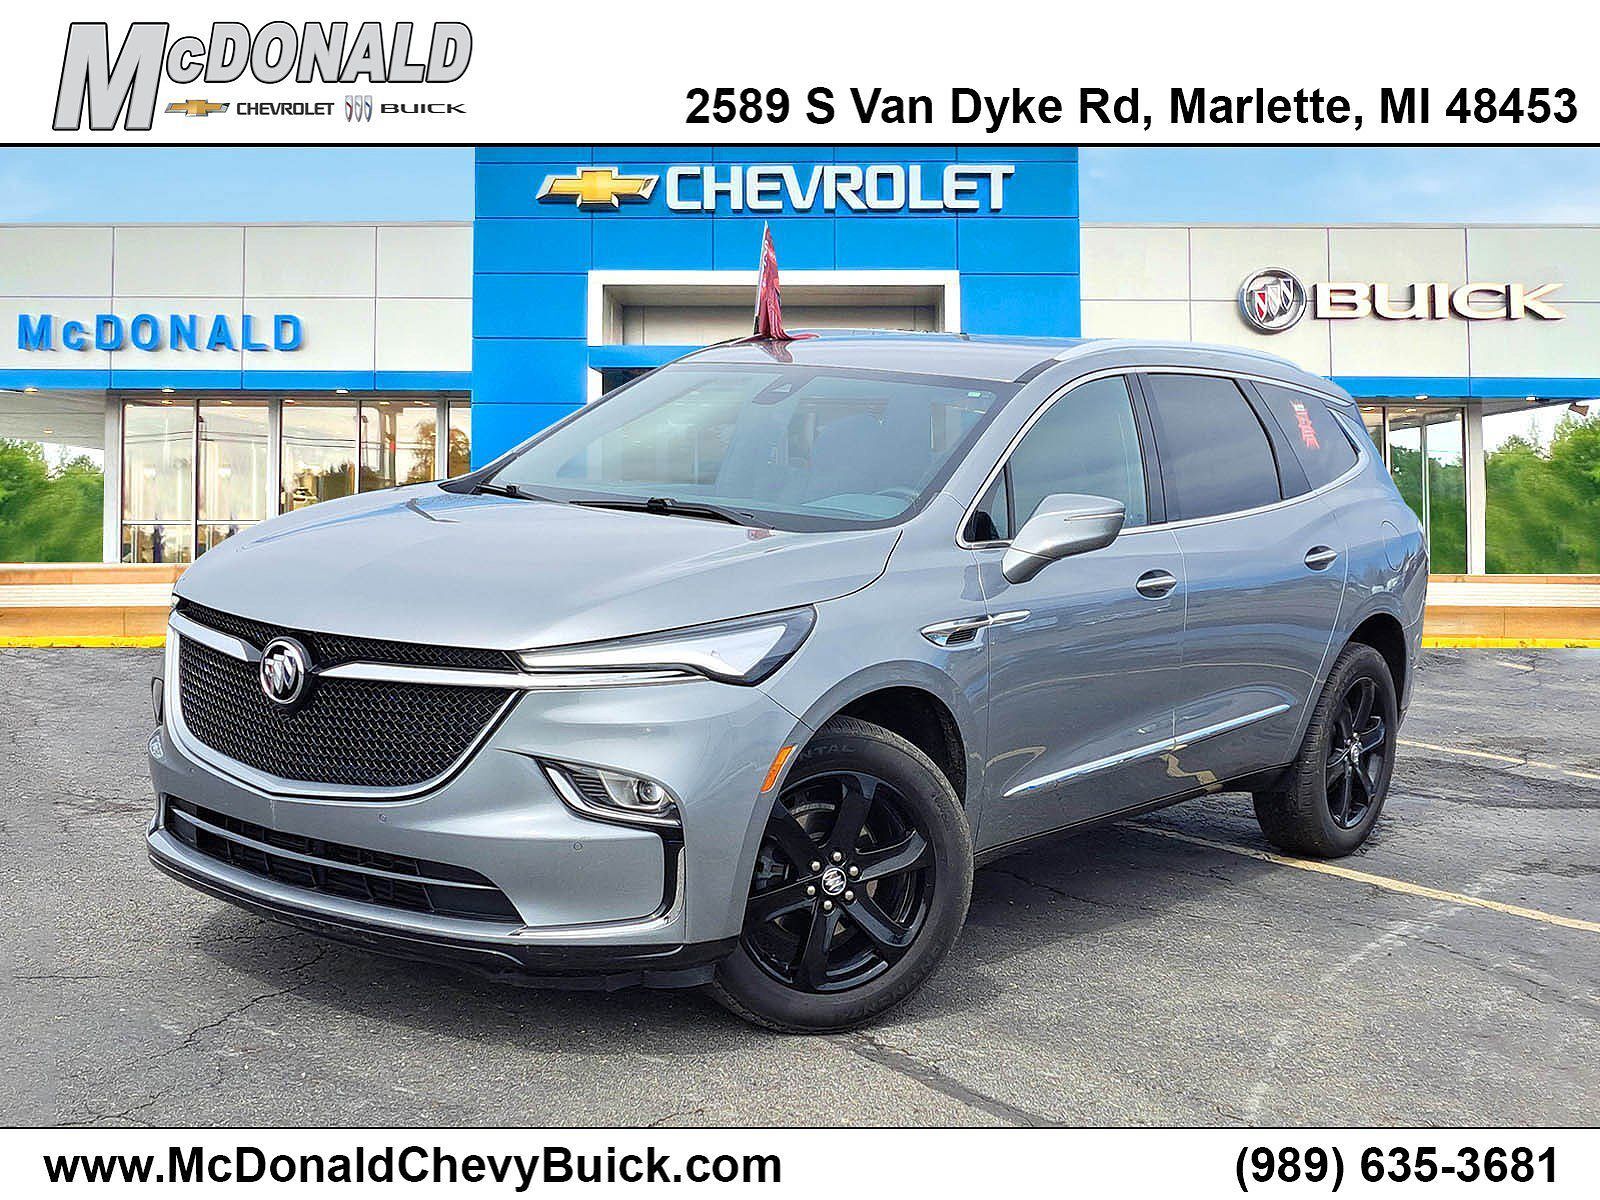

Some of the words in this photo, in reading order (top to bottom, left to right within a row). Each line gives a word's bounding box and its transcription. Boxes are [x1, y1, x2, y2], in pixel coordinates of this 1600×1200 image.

[666, 164, 1015, 211] CHEVROLET
[1313, 281, 1567, 320] BUICK
[17, 313, 304, 352] McDONALD
